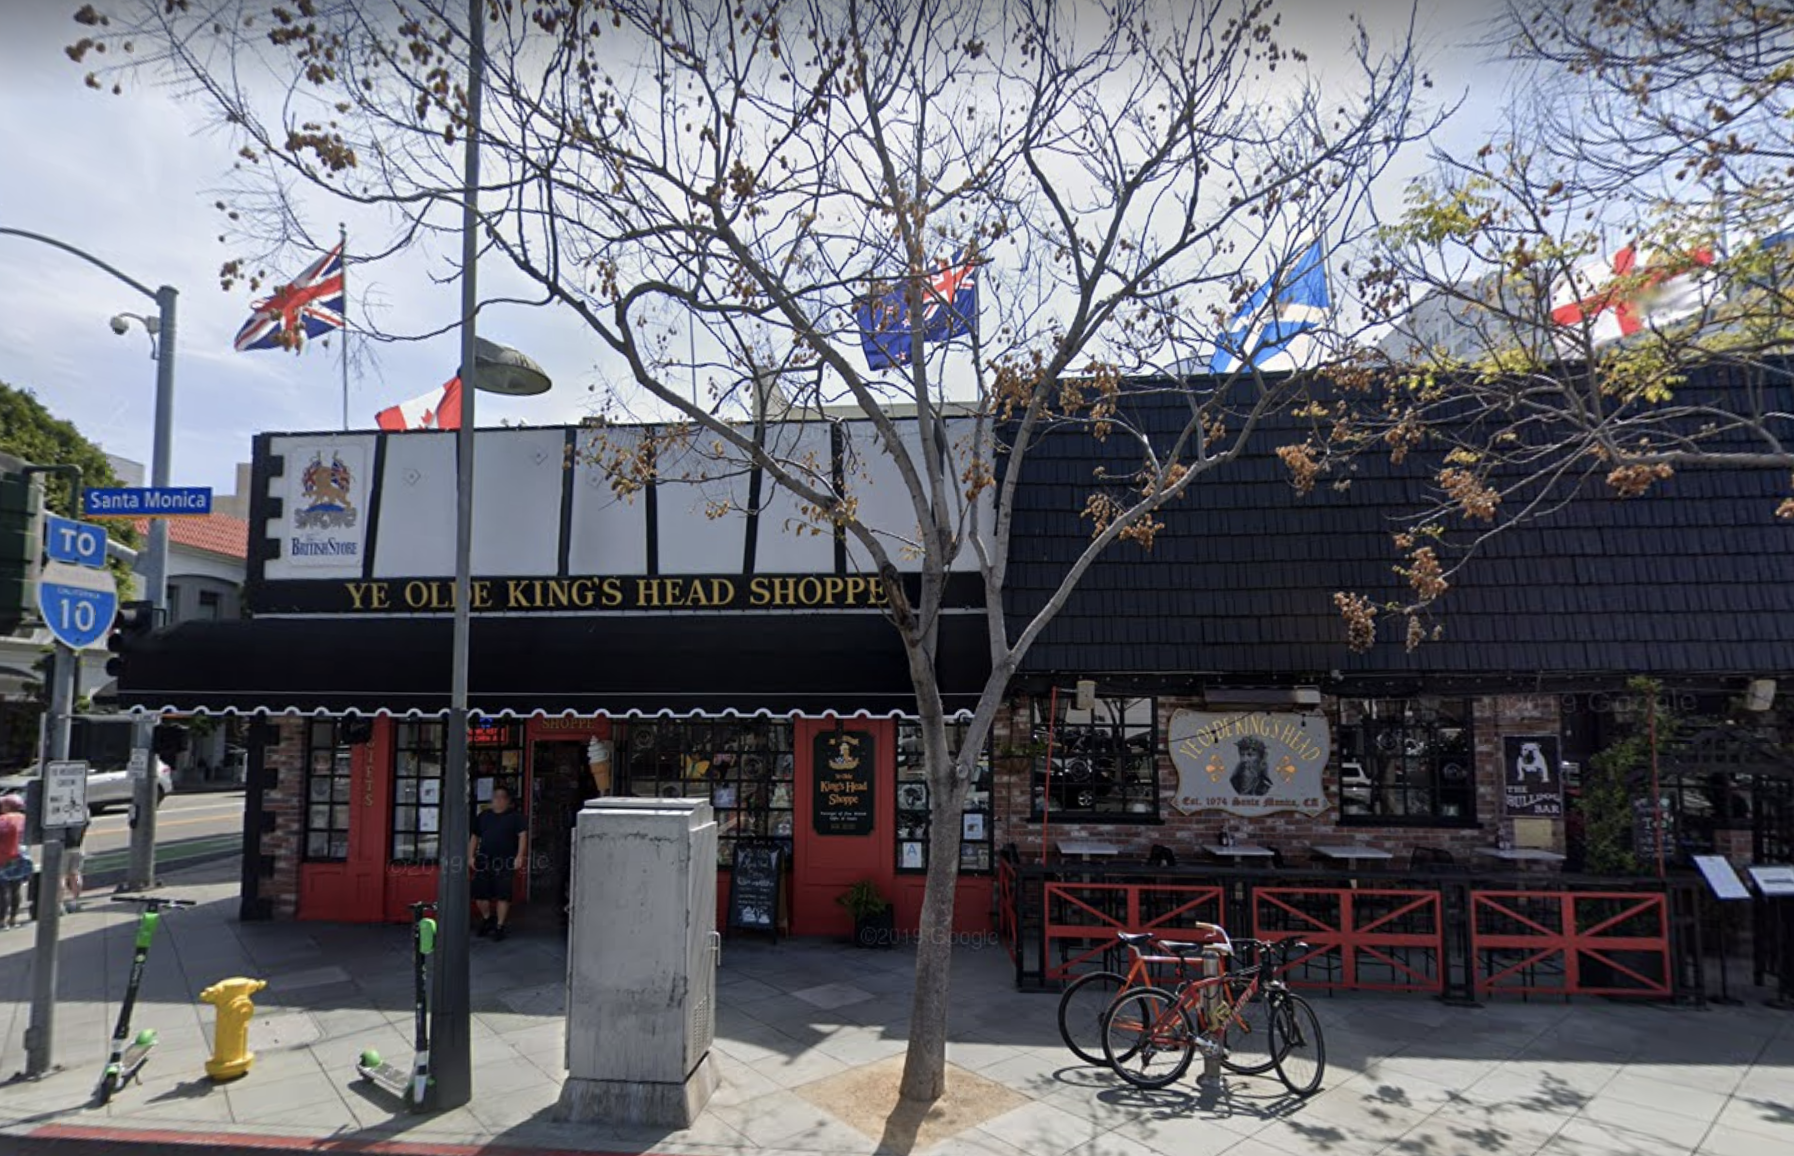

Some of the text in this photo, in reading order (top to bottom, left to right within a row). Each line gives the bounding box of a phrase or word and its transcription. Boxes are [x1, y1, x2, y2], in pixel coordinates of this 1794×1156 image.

[91, 491, 206, 508] Santa Monica
[60, 528, 96, 556] TO
[344, 582, 391, 609] YE
[507, 577, 623, 608] KING'S
[636, 578, 735, 607] HEAD
[750, 576, 889, 606] SHOPPE
[60, 598, 95, 632] 10
[542, 719, 595, 729] SHOPPE
[1179, 715, 1322, 762] YE OLDE KING'S HEAD
[846, 781, 868, 793] Head
[829, 793, 859, 806] Shoppe
[1533, 804, 1560, 814] BAR
[907, 844, 918, 856] A
